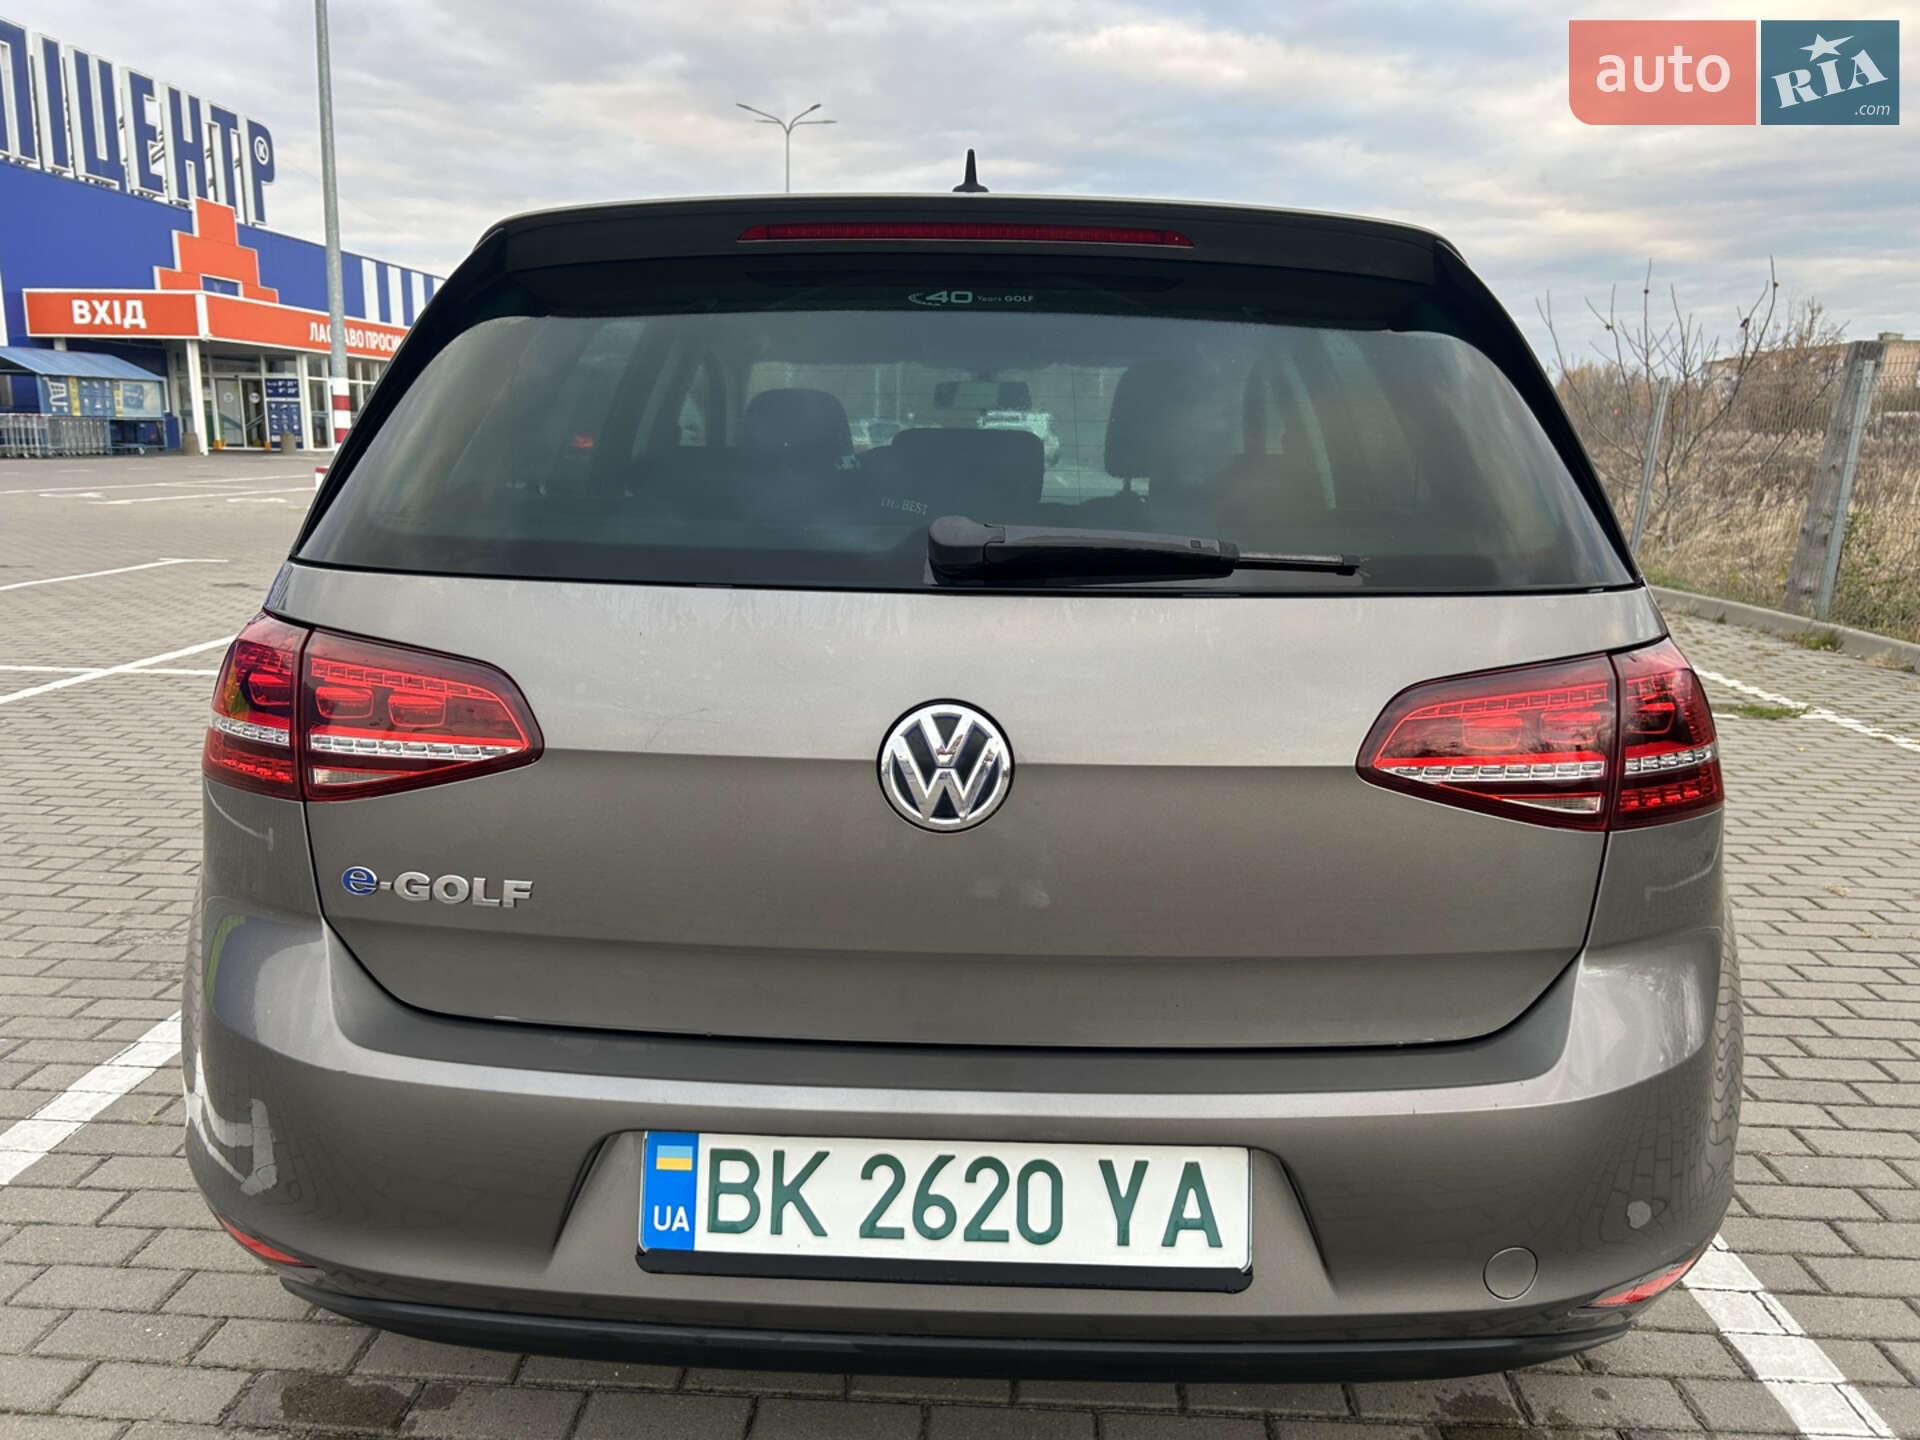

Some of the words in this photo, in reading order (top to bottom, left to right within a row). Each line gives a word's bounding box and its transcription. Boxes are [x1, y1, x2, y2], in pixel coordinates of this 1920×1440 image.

[926, 290, 973, 304] 40
[72, 299, 147, 329] ВХІД
[310, 321, 365, 349] ЛАСАВО
[341, 866, 534, 908] e-GOLF
[707, 1148, 830, 1237] BK
[859, 1153, 1064, 1245] 2620
[1099, 1159, 1223, 1248] YA
[653, 1205, 690, 1232] UA
